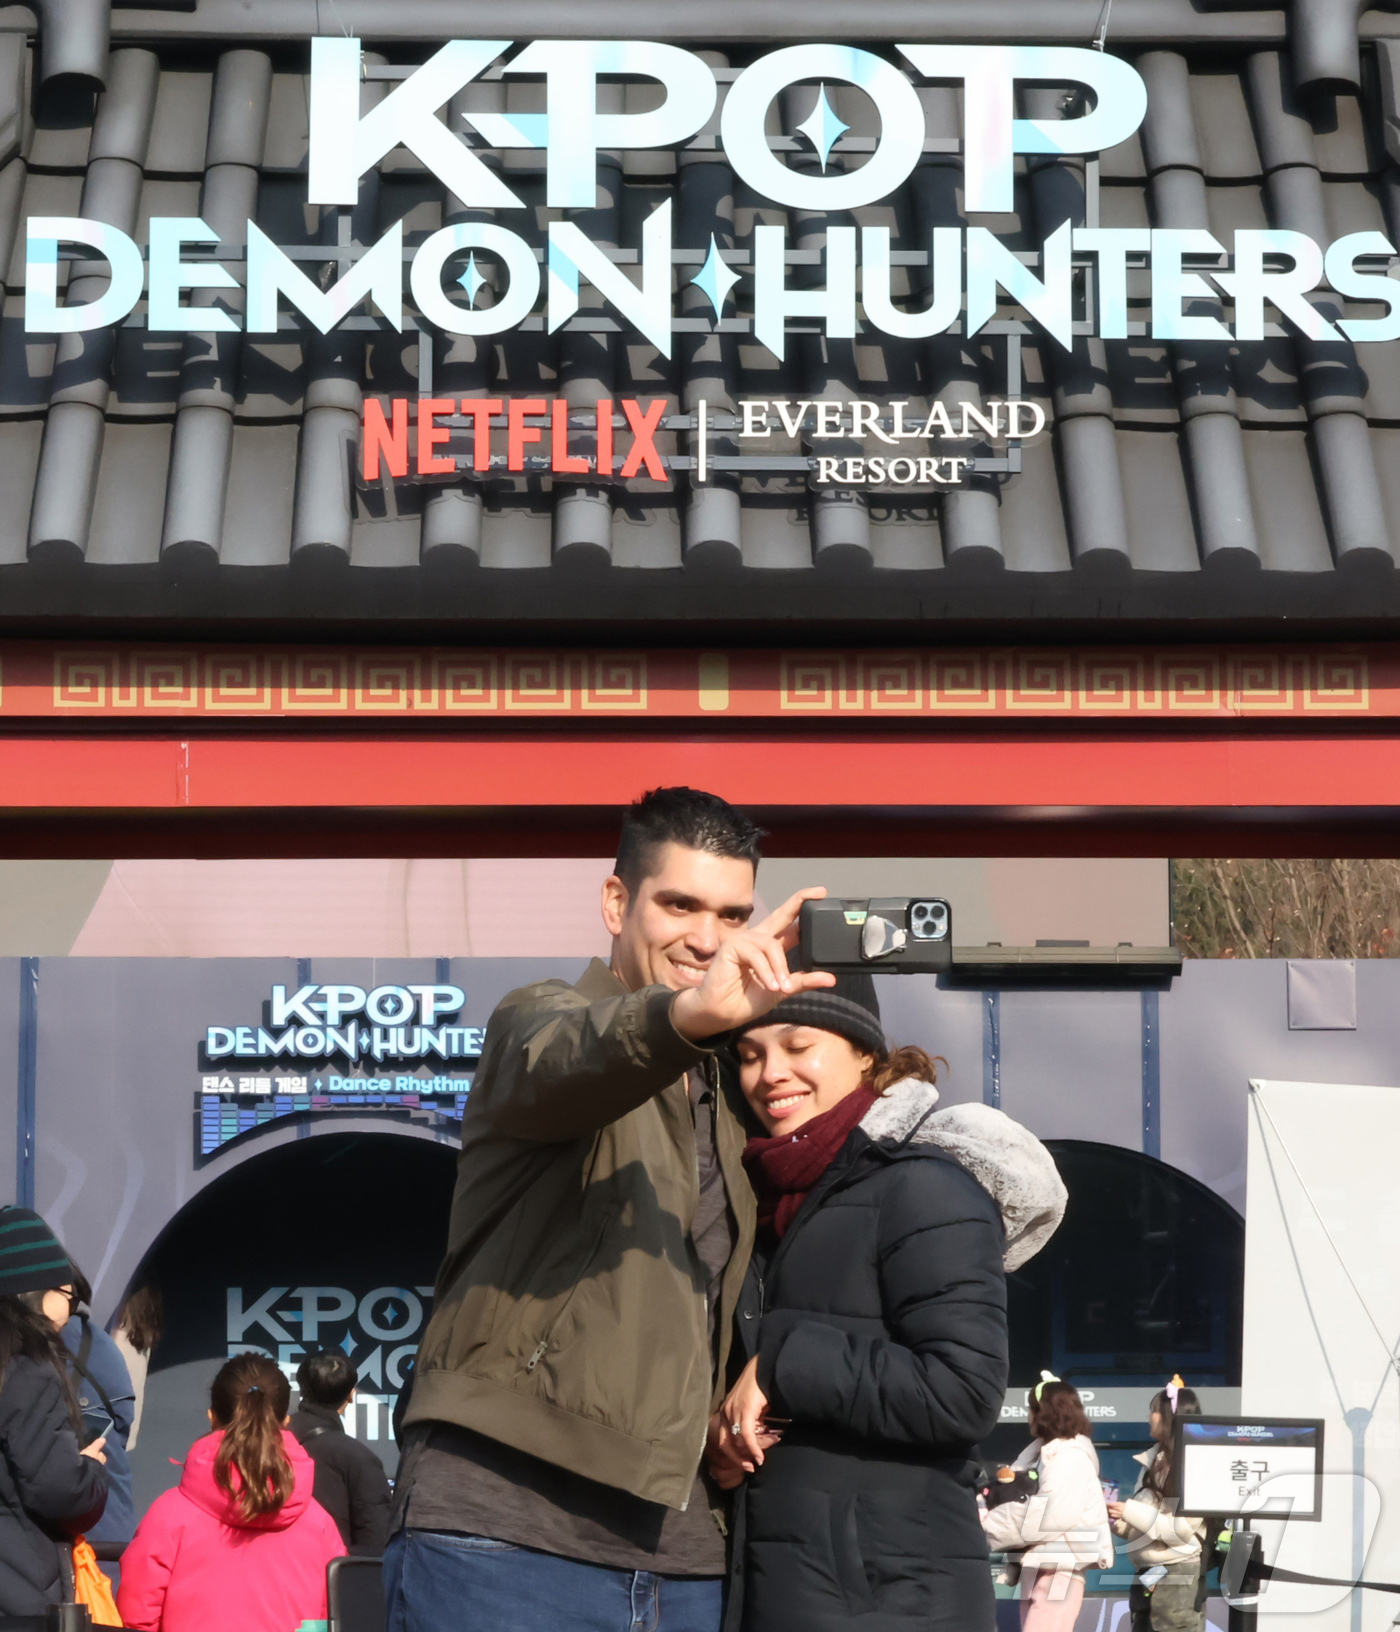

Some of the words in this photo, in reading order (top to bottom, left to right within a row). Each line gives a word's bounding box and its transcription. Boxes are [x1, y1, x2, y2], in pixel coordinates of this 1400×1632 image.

[309, 37, 1147, 212] KPOP
[25, 197, 671, 361] DEMON
[754, 218, 1400, 362] HUNTERS
[362, 398, 668, 482] NETFLIX
[738, 400, 1046, 444] EVERLAND
[816, 457, 967, 484] RESORT
[272, 985, 465, 1025] KPOP
[207, 1022, 357, 1060] DEMON
[372, 1026, 487, 1061] HUNTE
[202, 1076, 235, 1093] 댄스
[239, 1077, 271, 1093] 리듬
[275, 1076, 308, 1093] 게임
[329, 1076, 391, 1092] Dance
[395, 1076, 471, 1093] Rhythm
[1230, 1460, 1270, 1481] 출구
[1238, 1486, 1261, 1496] Exit
